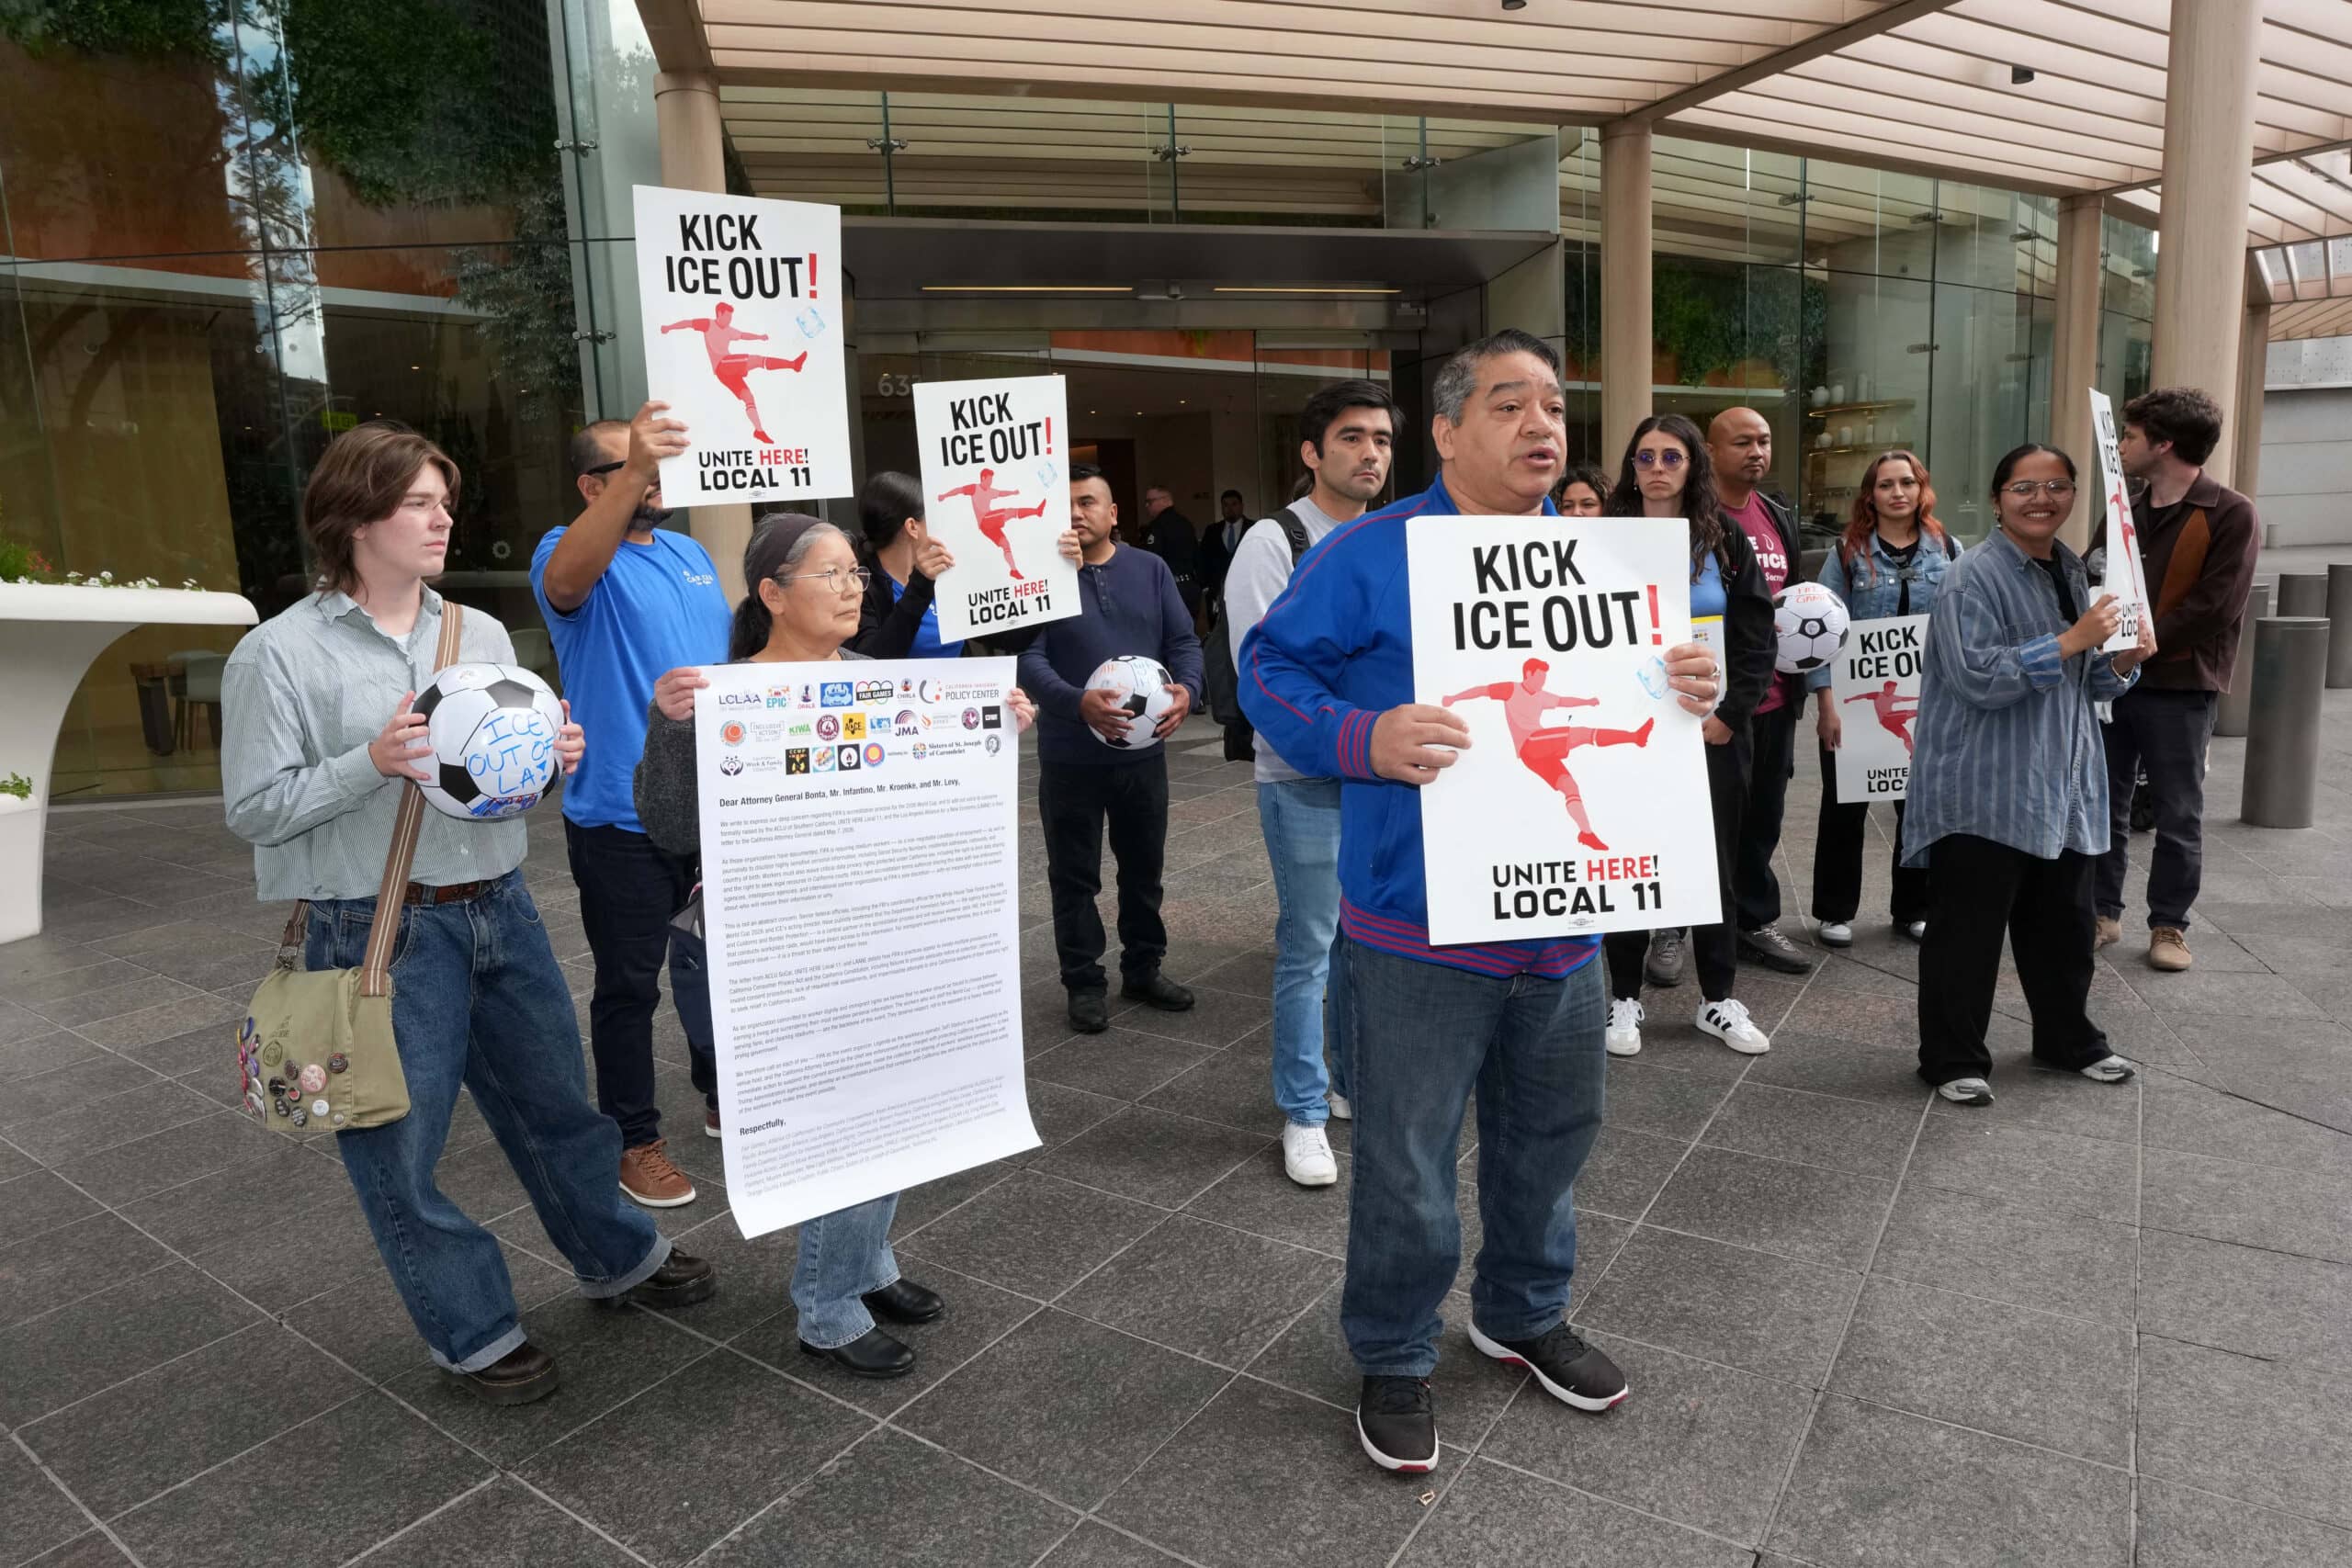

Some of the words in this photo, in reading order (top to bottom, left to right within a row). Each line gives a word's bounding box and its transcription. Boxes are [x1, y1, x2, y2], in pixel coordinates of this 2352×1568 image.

[680, 214, 762, 251] KICK
[666, 256, 721, 294] ICE
[877, 375, 922, 396] 63
[950, 392, 1013, 431] KICK
[698, 451, 753, 467] UNITE
[760, 449, 809, 465] HERE!
[941, 434, 985, 466] ICE
[700, 468, 779, 491] LOCAL
[790, 467, 811, 486] 11
[1473, 539, 1586, 593] KICK
[968, 587, 1010, 606] UNITE
[1014, 579, 1048, 598] HERE!
[970, 599, 1028, 626] LOCAL
[1035, 595, 1050, 612] 11
[1453, 601, 1532, 650] ICE
[1860, 625, 1919, 654] KICK
[1850, 656, 1889, 679] ICE
[719, 694, 761, 705] LCLAA
[766, 698, 787, 709] EPIC
[946, 691, 970, 700] POLICY
[972, 689, 999, 698] CENTER
[483, 714, 543, 745] ICE
[895, 726, 918, 736] JMA
[468, 745, 522, 777] OUT
[531, 736, 554, 761] OF
[1867, 767, 1908, 779] UNITE
[719, 798, 738, 807] Dear
[740, 794, 773, 807] Attorney
[774, 792, 802, 802] General
[805, 790, 828, 802] Bonta,
[829, 788, 841, 797] Mr.
[842, 785, 875, 798] Infantino,
[876, 784, 888, 793] Mr.
[889, 781, 918, 794] Kroenke,
[919, 780, 931, 789] and
[932, 778, 942, 787] Mr.
[944, 777, 960, 788] Levy,
[1493, 861, 1577, 888] UNITE
[1587, 855, 1658, 881] HERE!
[1494, 885, 1615, 920] LOCAL
[1632, 881, 1662, 910] 11
[740, 1118, 786, 1136] Respectfully,
